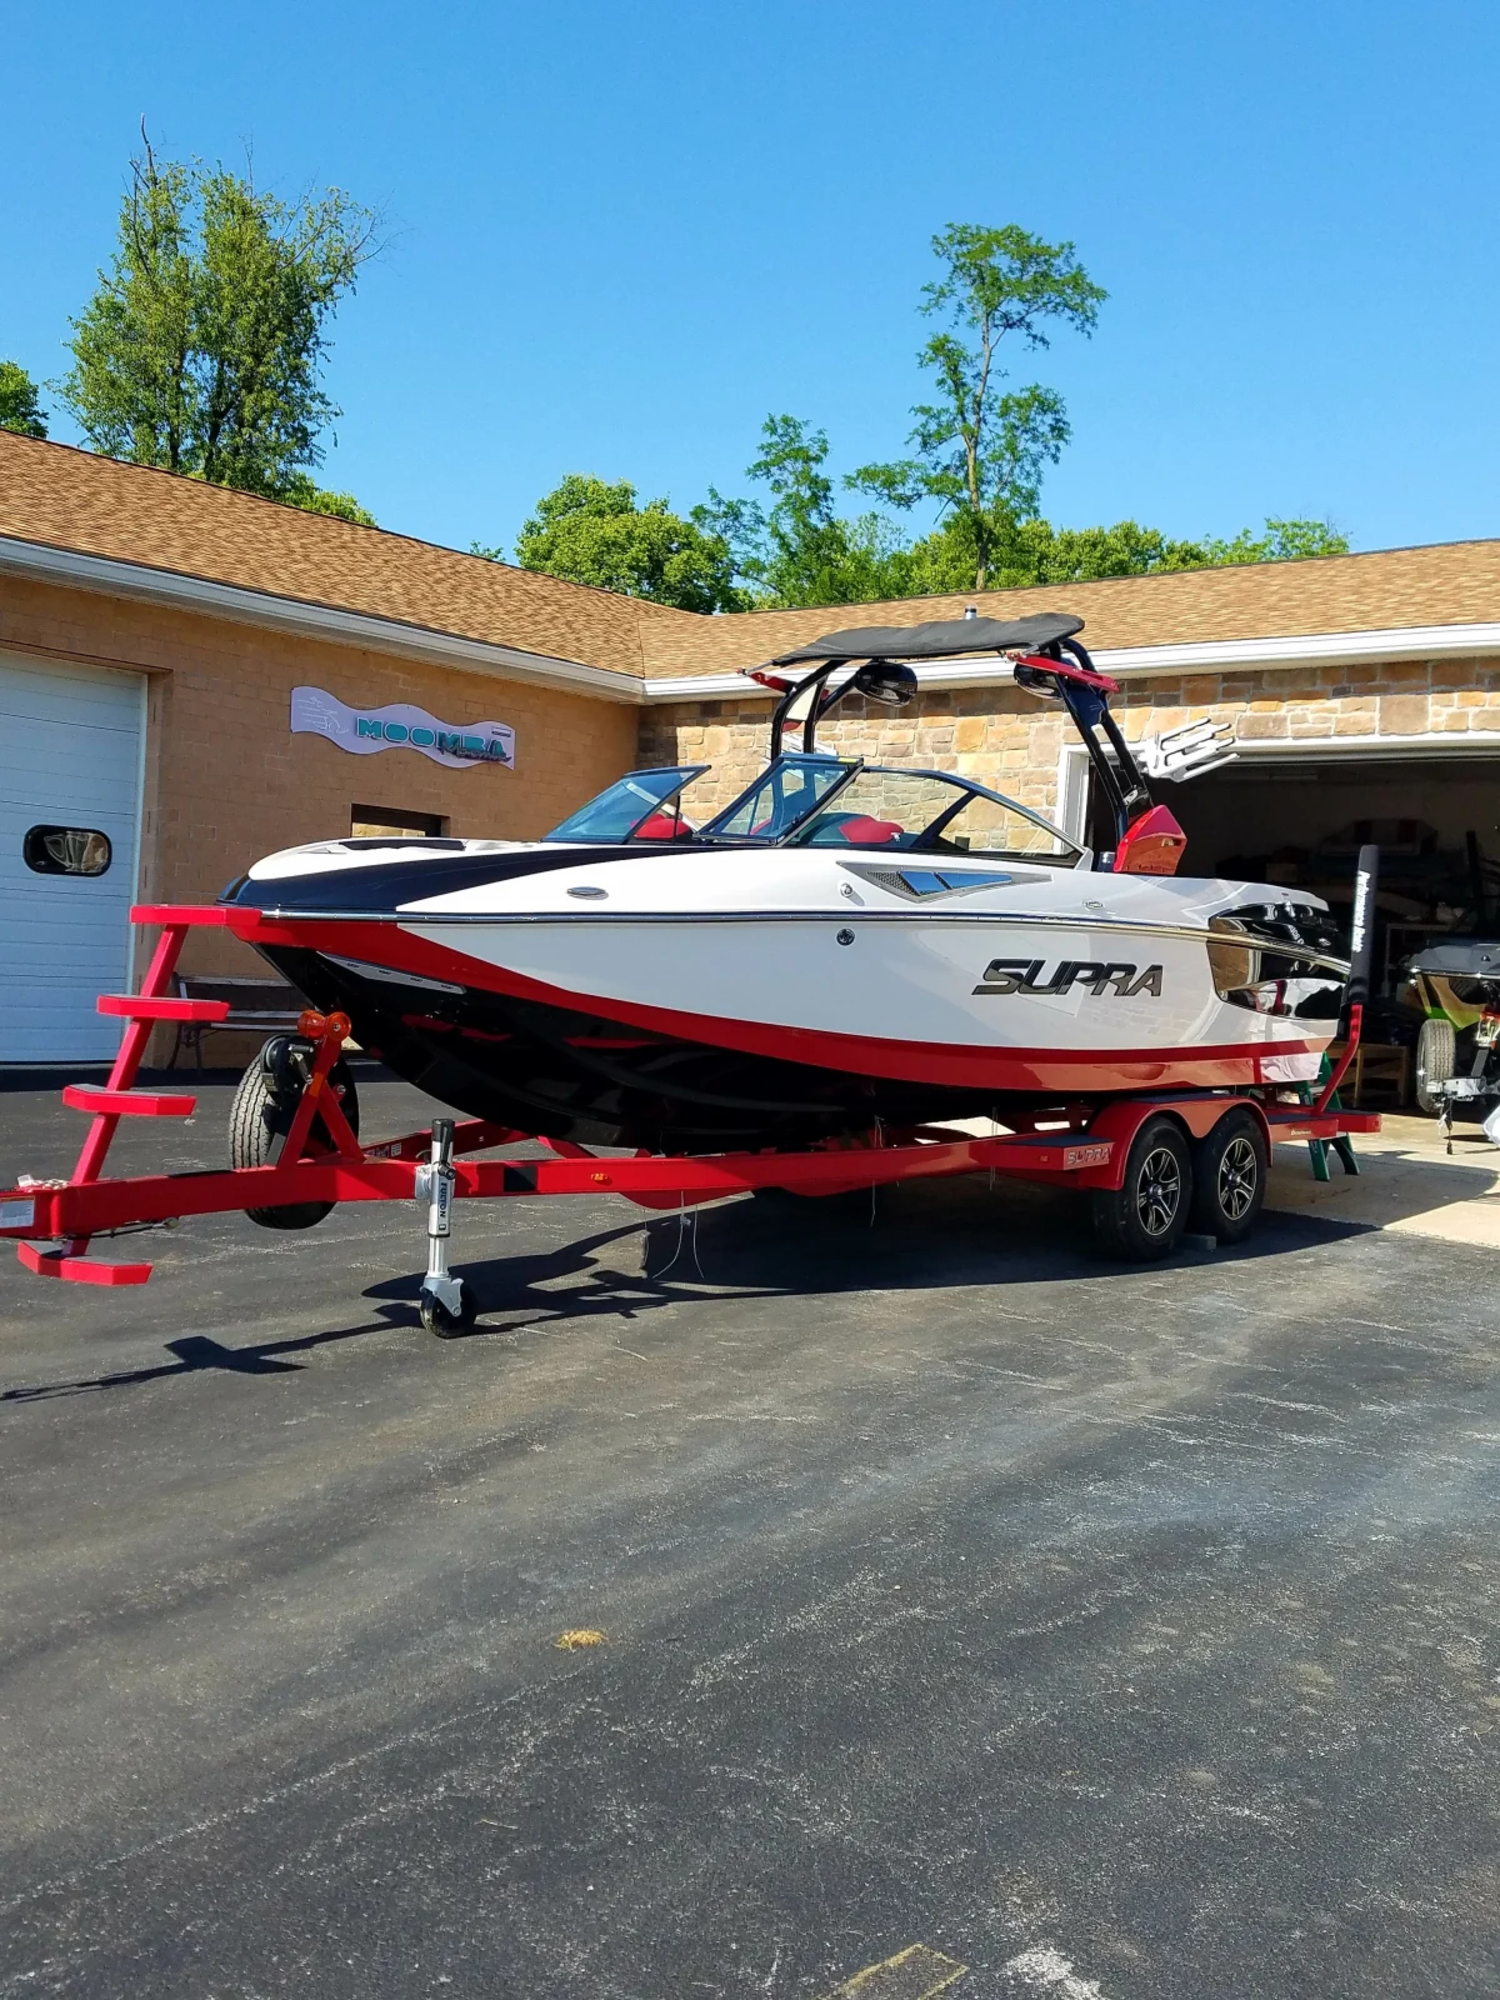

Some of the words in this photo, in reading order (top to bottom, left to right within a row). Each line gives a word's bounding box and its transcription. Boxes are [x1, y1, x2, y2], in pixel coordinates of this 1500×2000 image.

[356, 716, 507, 759] MOOMBA
[1351, 925, 1366, 953] Boats
[971, 958, 1163, 997] SUPRA
[1067, 1148, 1110, 1165] SUPRA
